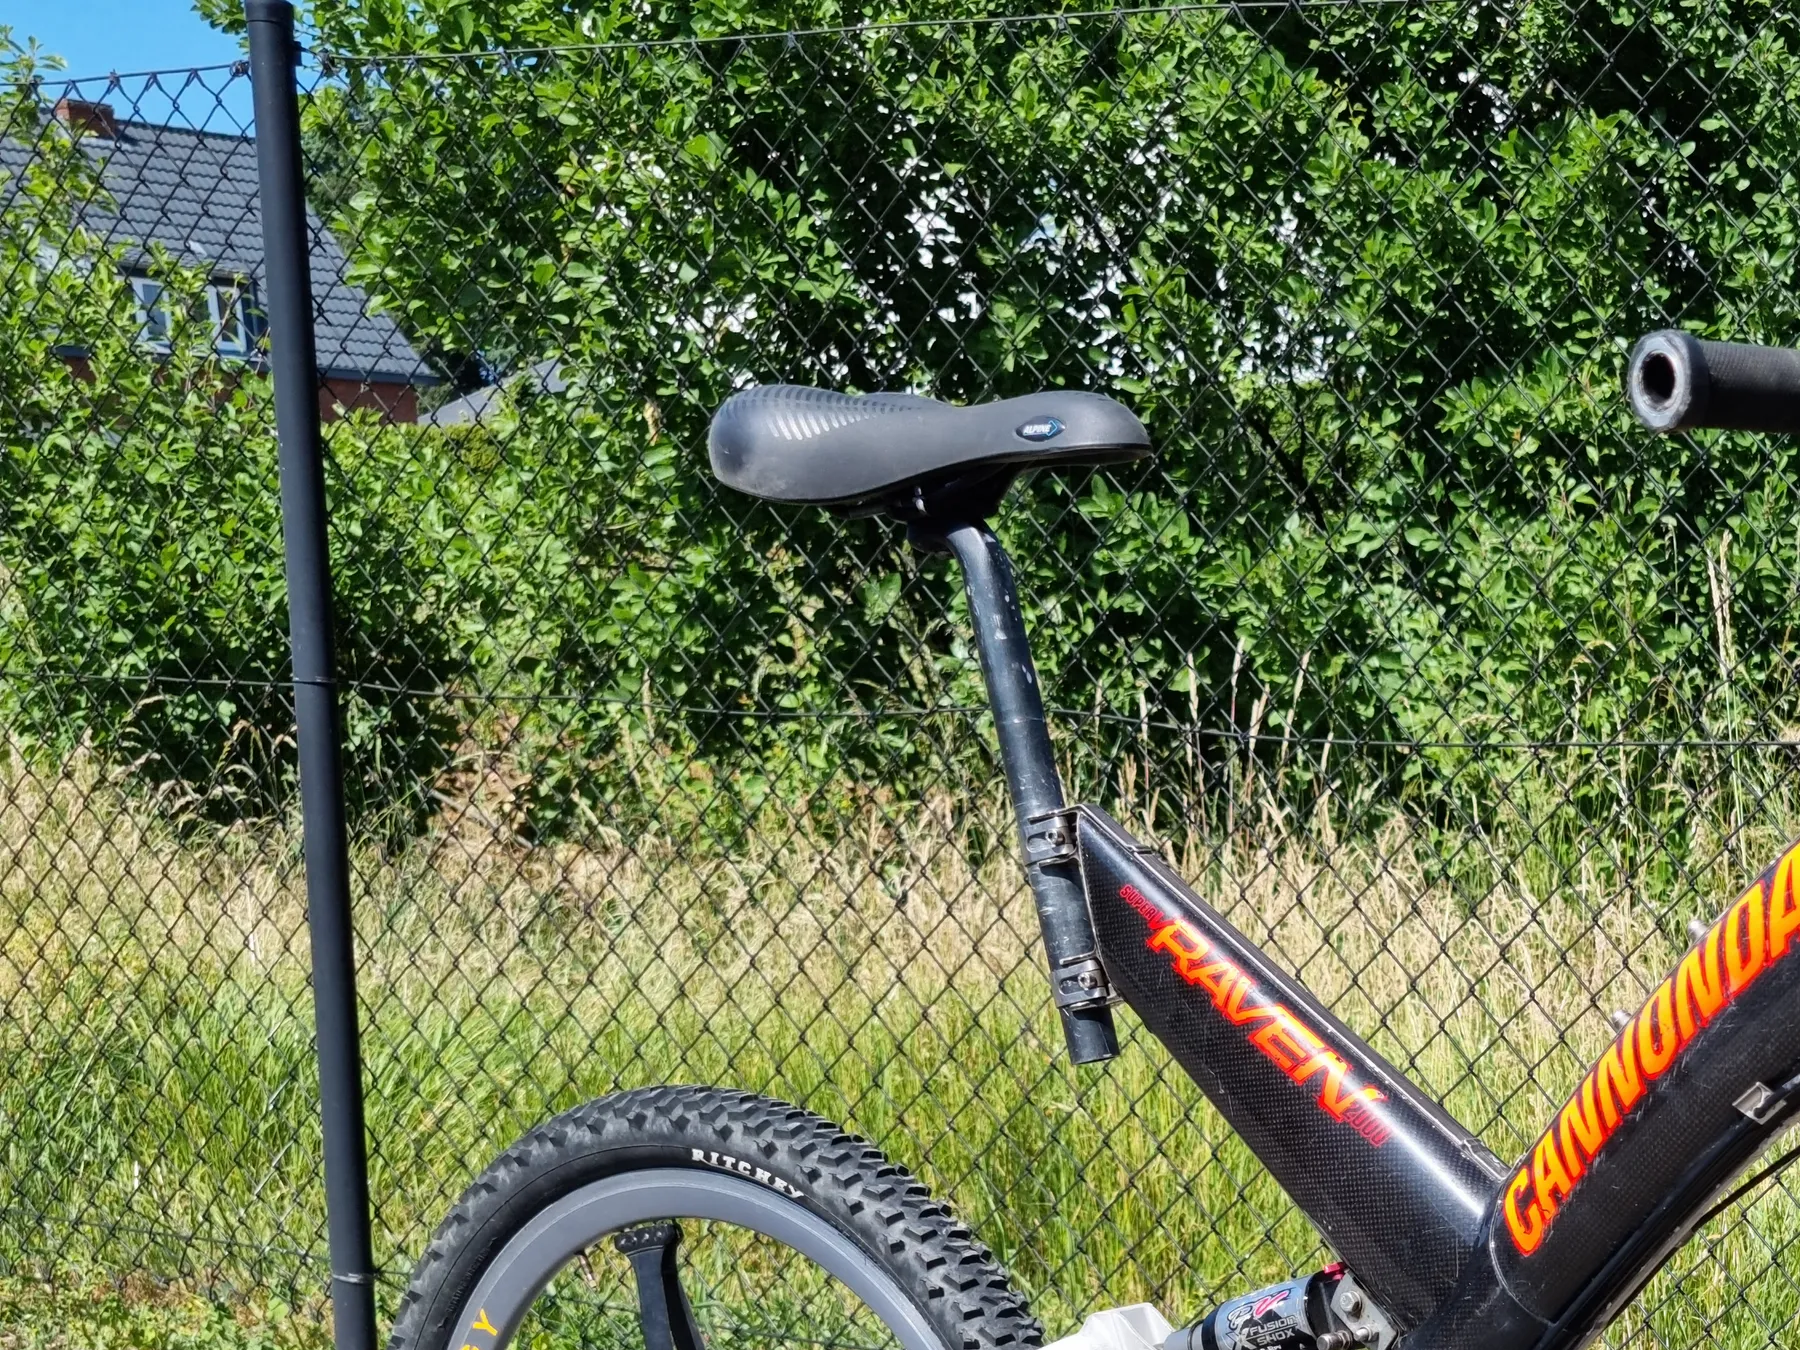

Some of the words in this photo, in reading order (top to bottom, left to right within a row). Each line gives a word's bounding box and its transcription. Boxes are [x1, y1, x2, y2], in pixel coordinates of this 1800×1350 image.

[1119, 883, 1159, 921] SUPER
[1146, 917, 1388, 1124] RAVEN
[691, 1148, 804, 1198] RITCHEY
[1256, 1328, 1296, 1347] SHOX
